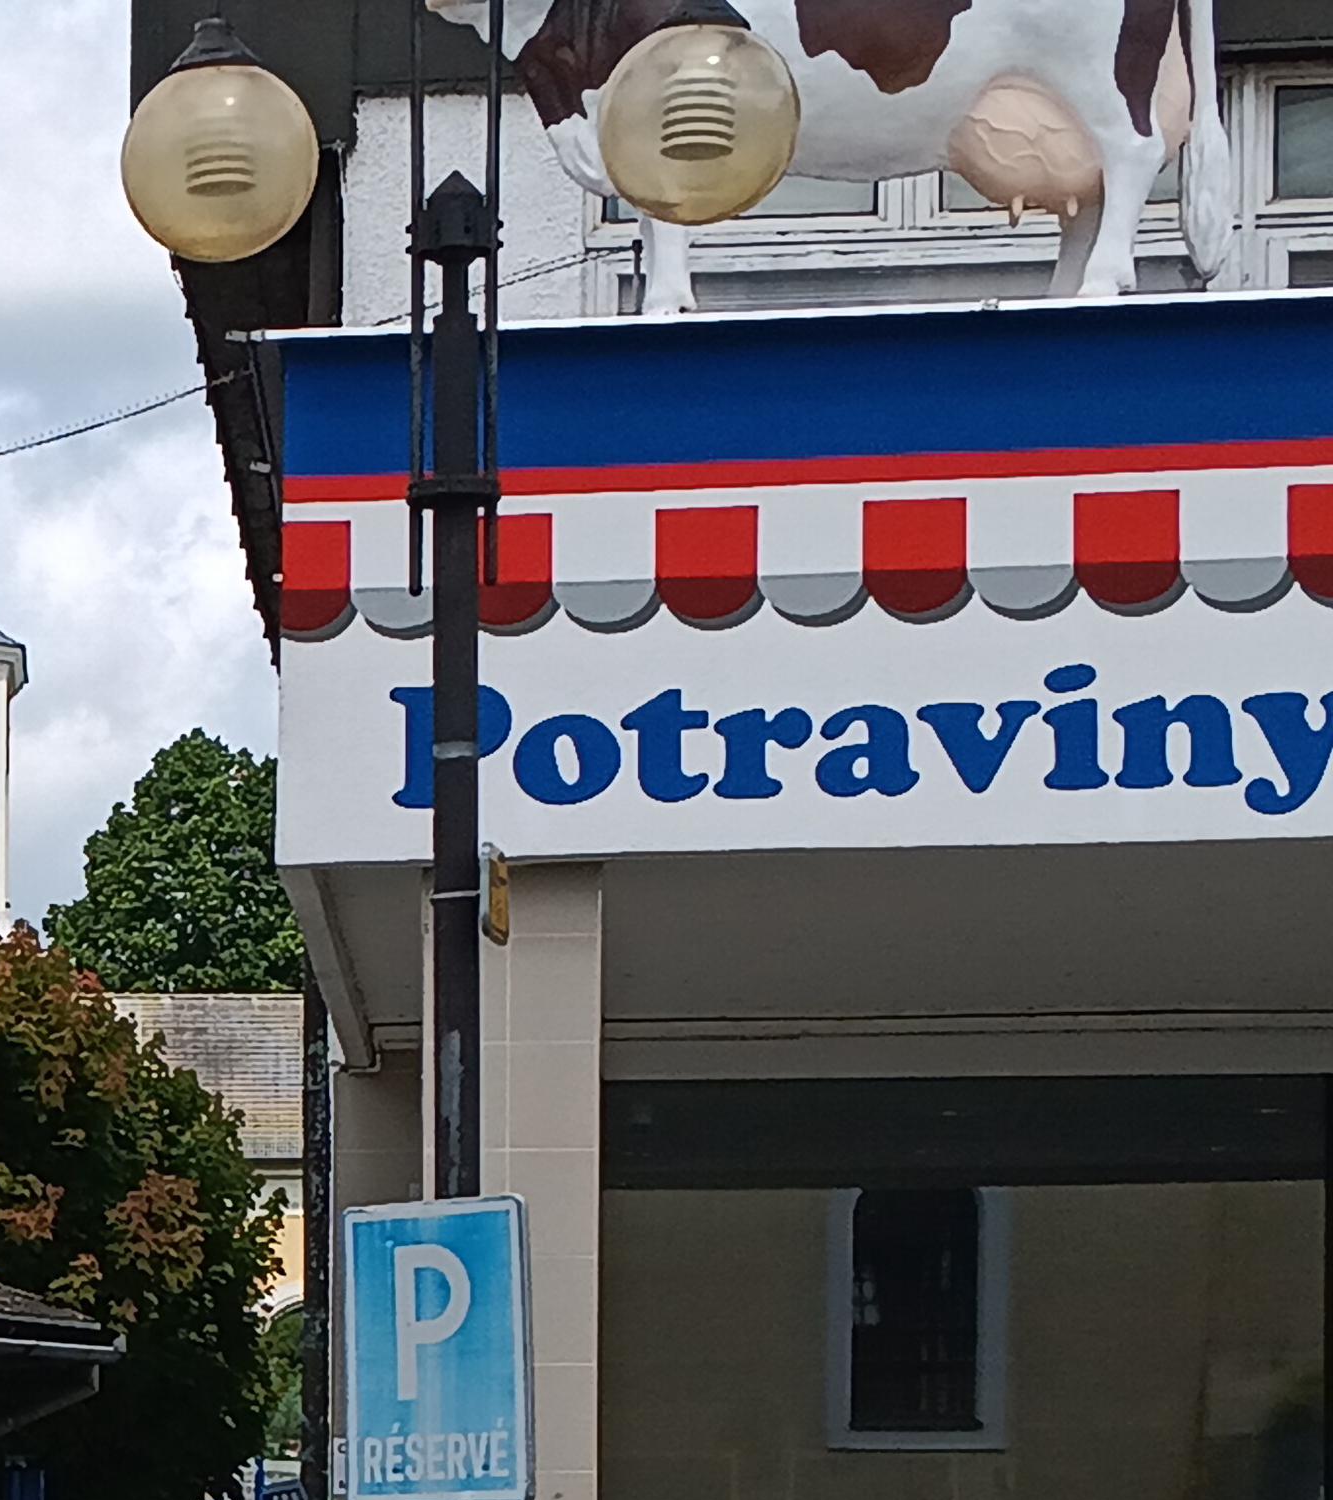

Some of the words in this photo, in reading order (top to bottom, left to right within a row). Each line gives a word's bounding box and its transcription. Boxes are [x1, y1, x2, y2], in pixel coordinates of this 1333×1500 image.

[389, 663, 1333, 815] Potraviny
[394, 1243, 470, 1400] P
[363, 1416, 510, 1484] RÉSERVÉ
